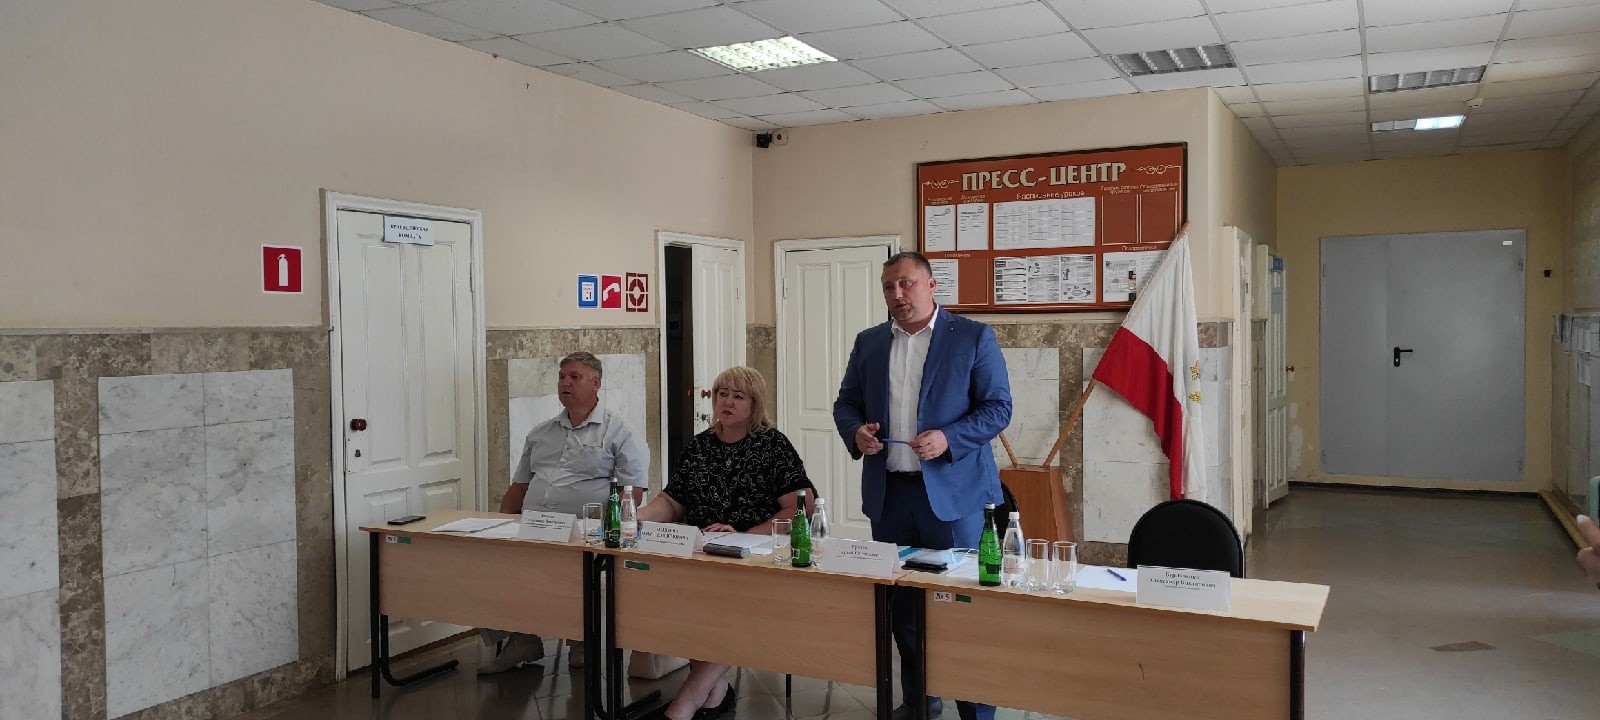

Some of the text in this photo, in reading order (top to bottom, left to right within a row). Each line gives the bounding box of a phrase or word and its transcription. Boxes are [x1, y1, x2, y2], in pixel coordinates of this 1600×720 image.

[962, 162, 1127, 191] ПРЕСС-ЦЕНТР
[1016, 192, 1060, 200] Расписание
[945, 593, 950, 601] 5
